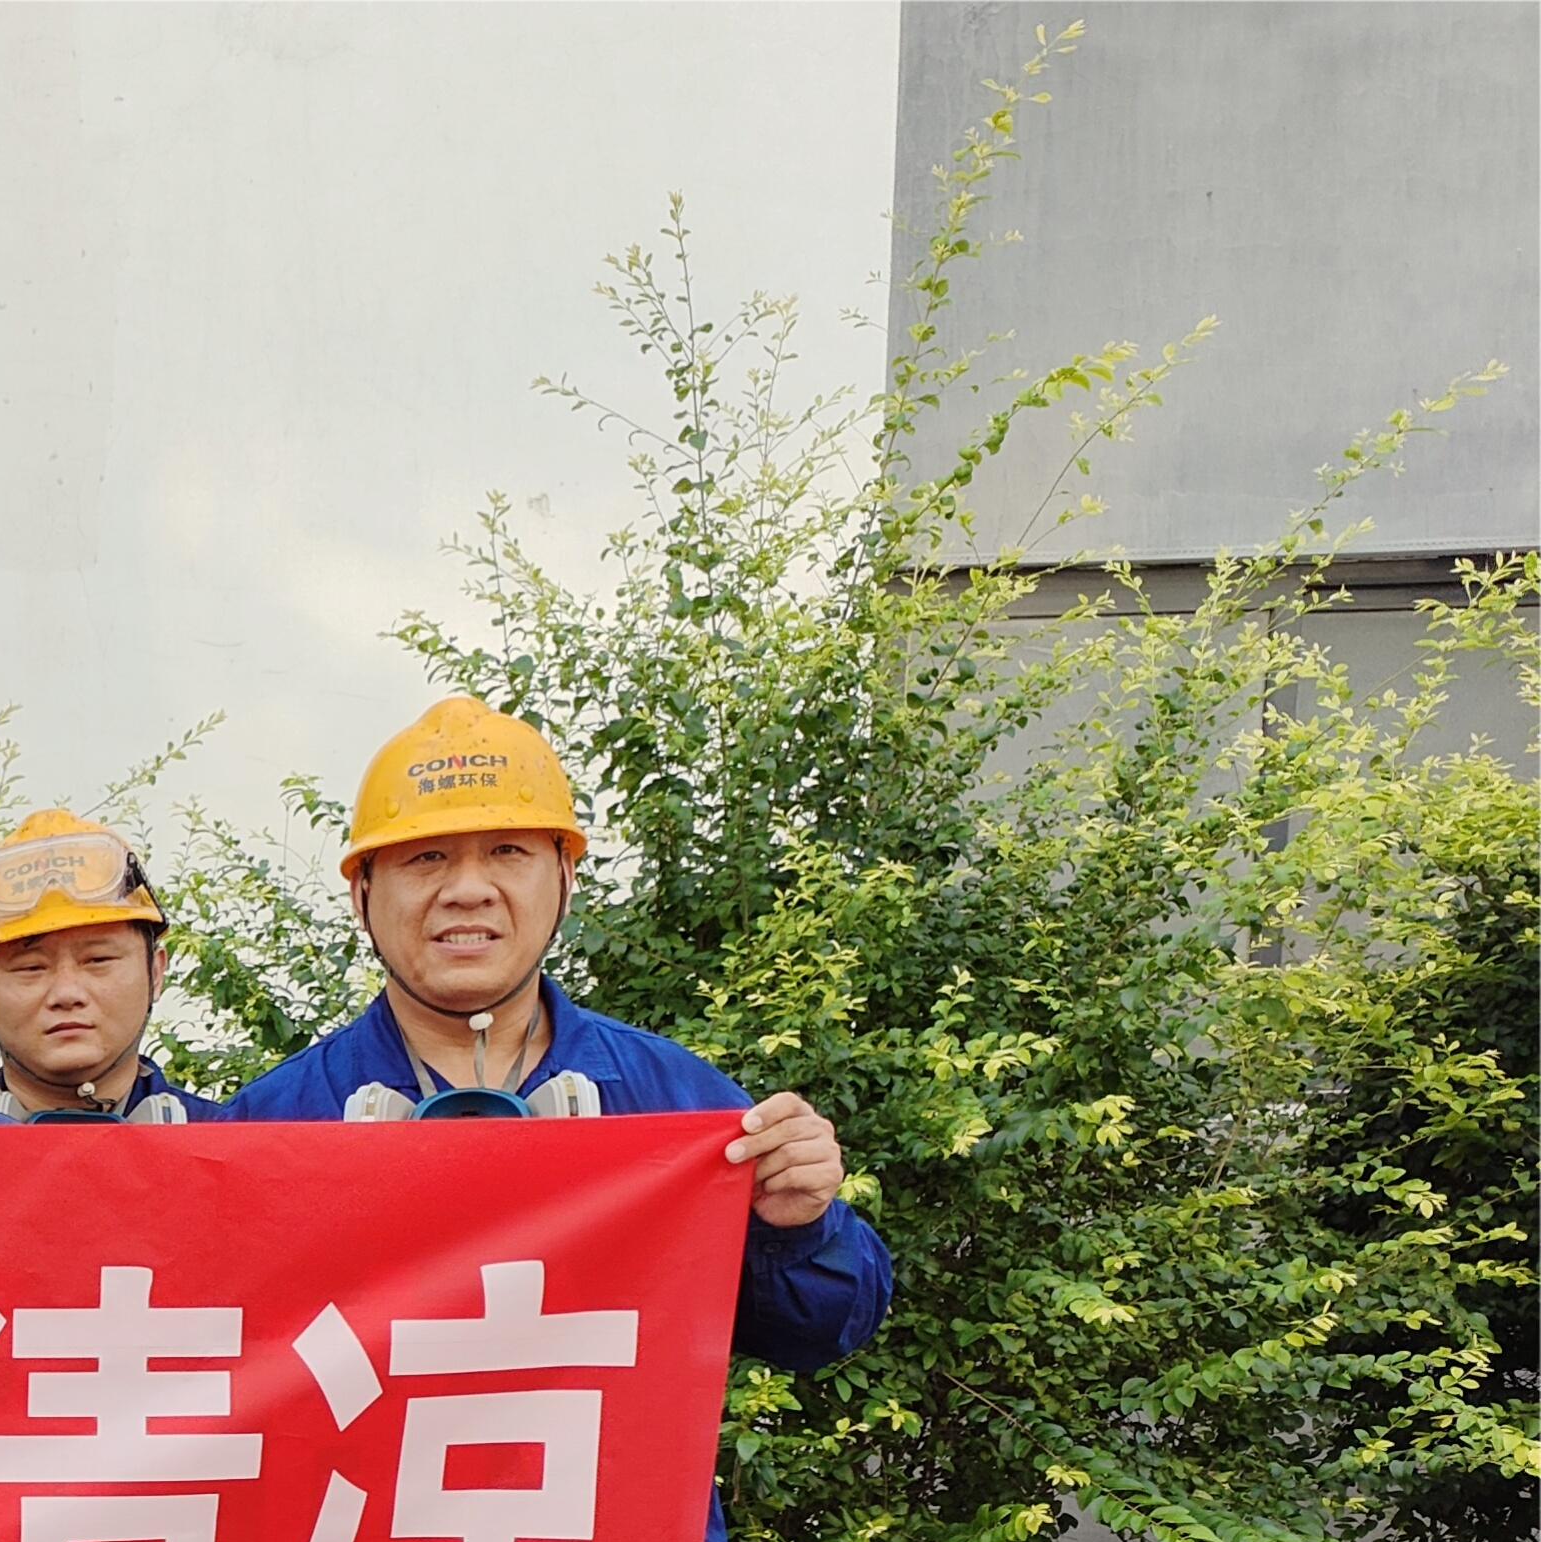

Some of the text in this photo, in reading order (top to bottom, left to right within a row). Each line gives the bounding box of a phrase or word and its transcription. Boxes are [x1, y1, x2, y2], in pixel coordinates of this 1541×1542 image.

[408, 755, 506, 776] CONCH
[419, 773, 497, 794] 海螺环保
